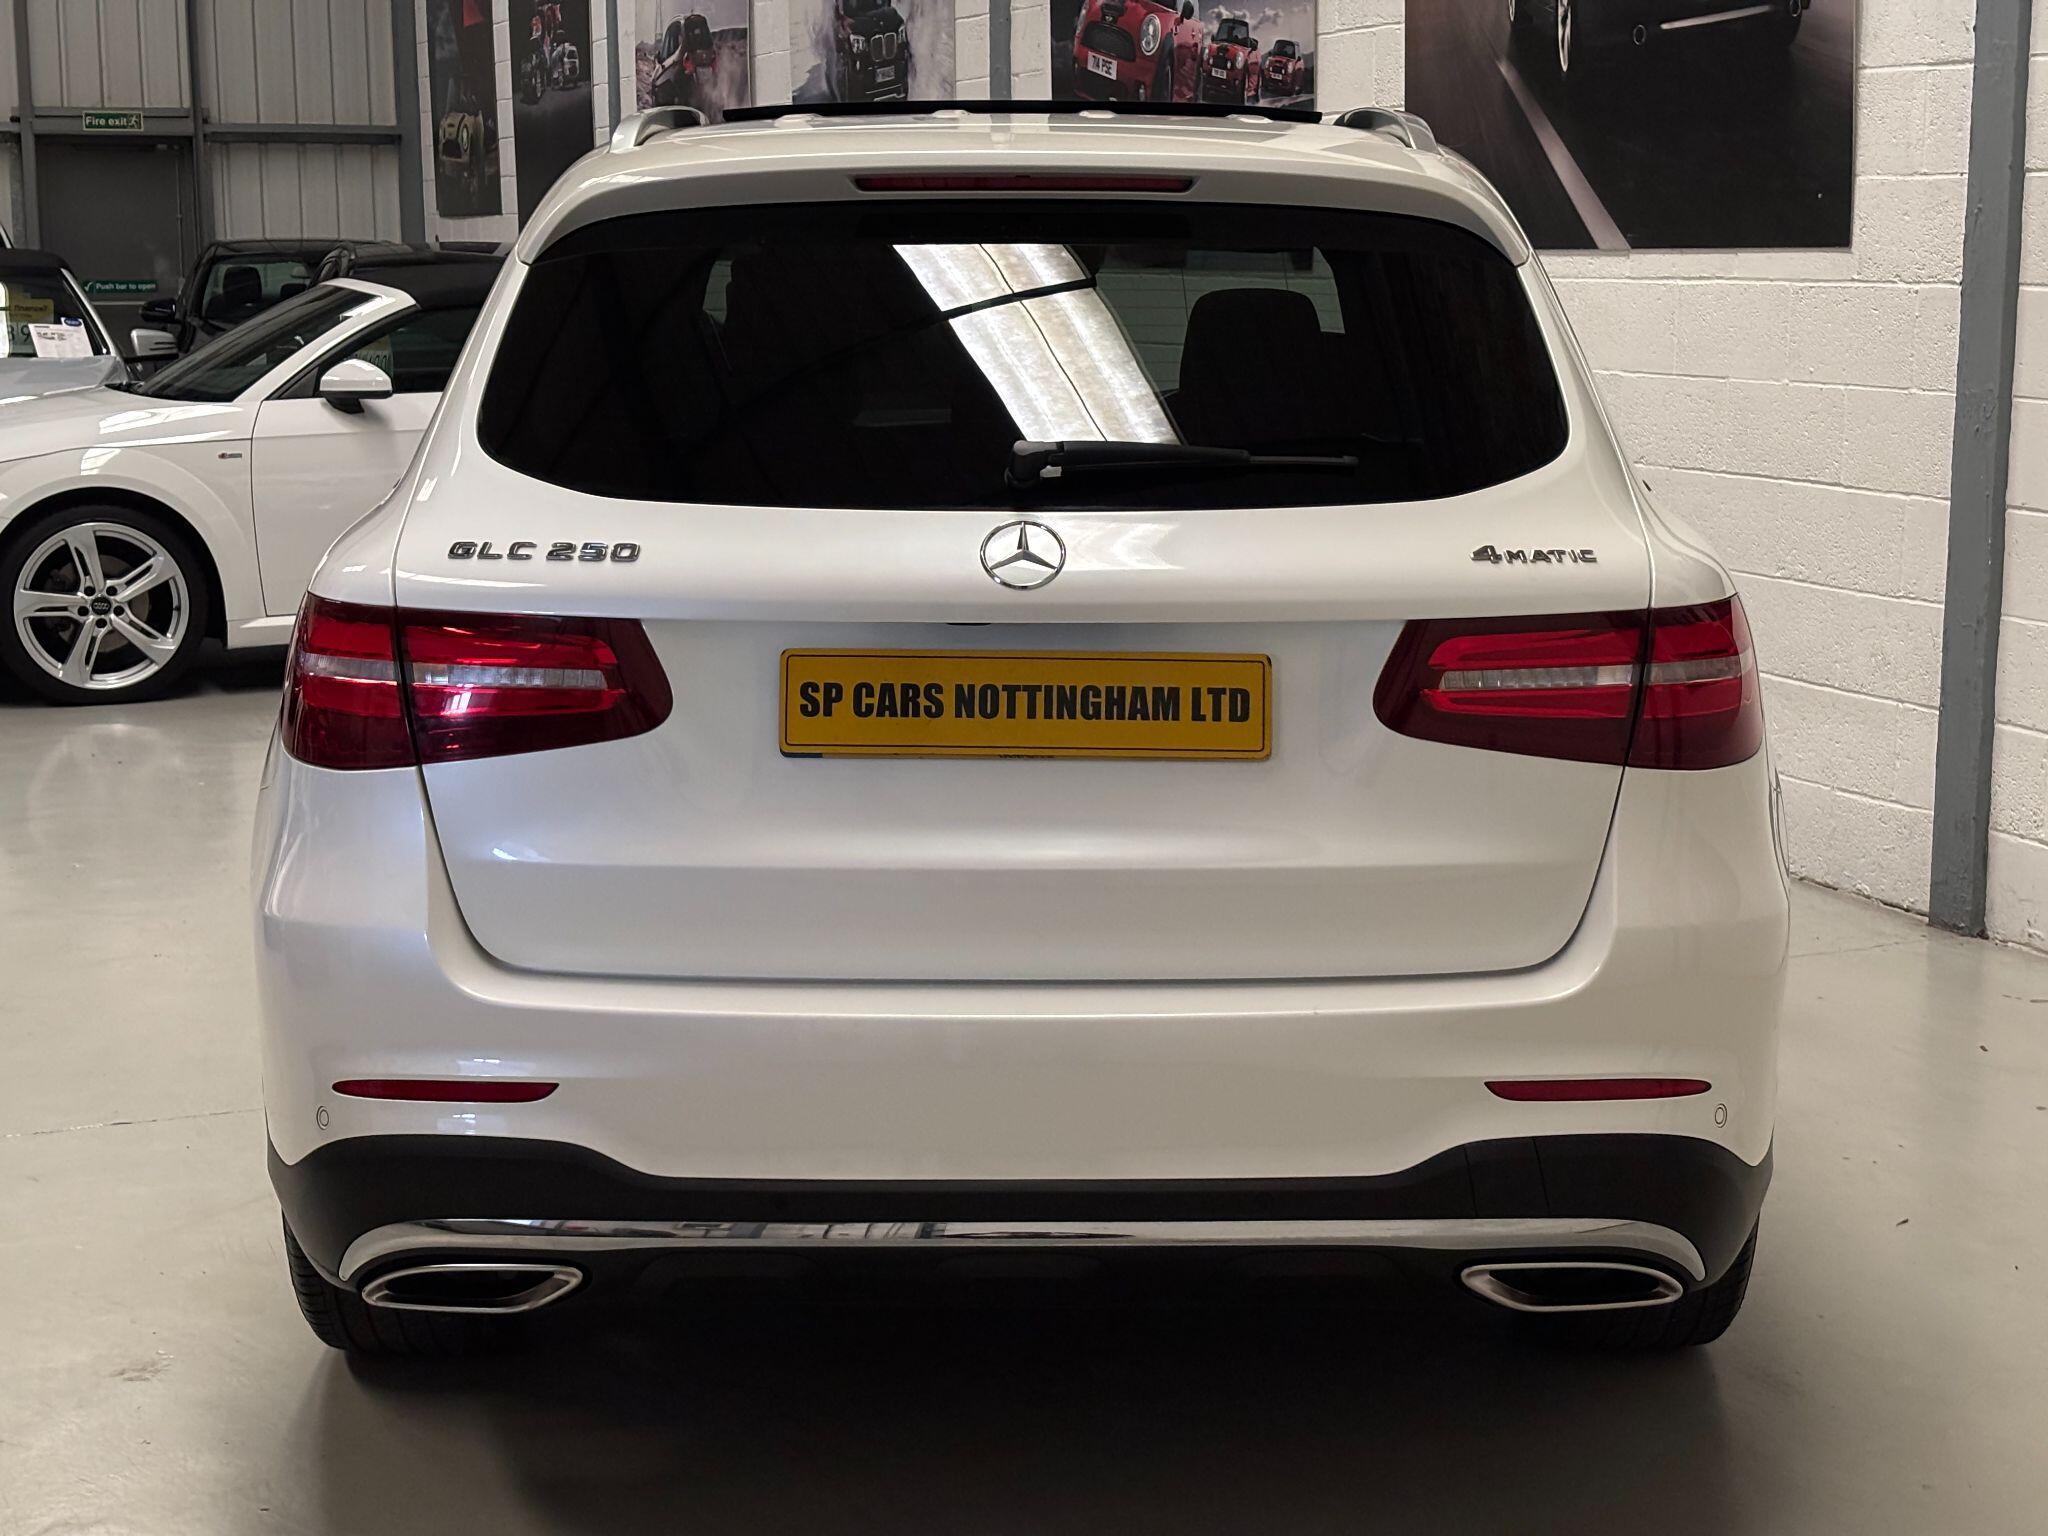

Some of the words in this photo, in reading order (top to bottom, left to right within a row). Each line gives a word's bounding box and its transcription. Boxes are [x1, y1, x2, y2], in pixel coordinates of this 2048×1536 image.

[85, 116, 106, 126] Fire
[108, 116, 128, 126] exit
[95, 282, 114, 290] Push
[115, 282, 127, 290] bar
[137, 283, 156, 291] open
[448, 541, 537, 560] GLC
[546, 542, 641, 562] 250
[1470, 545, 1597, 564] 4MATIC
[800, 681, 844, 718] SP
[853, 682, 945, 719] CARS
[954, 683, 1180, 721] NOTTINGHAM
[1191, 687, 1250, 723] LTD
